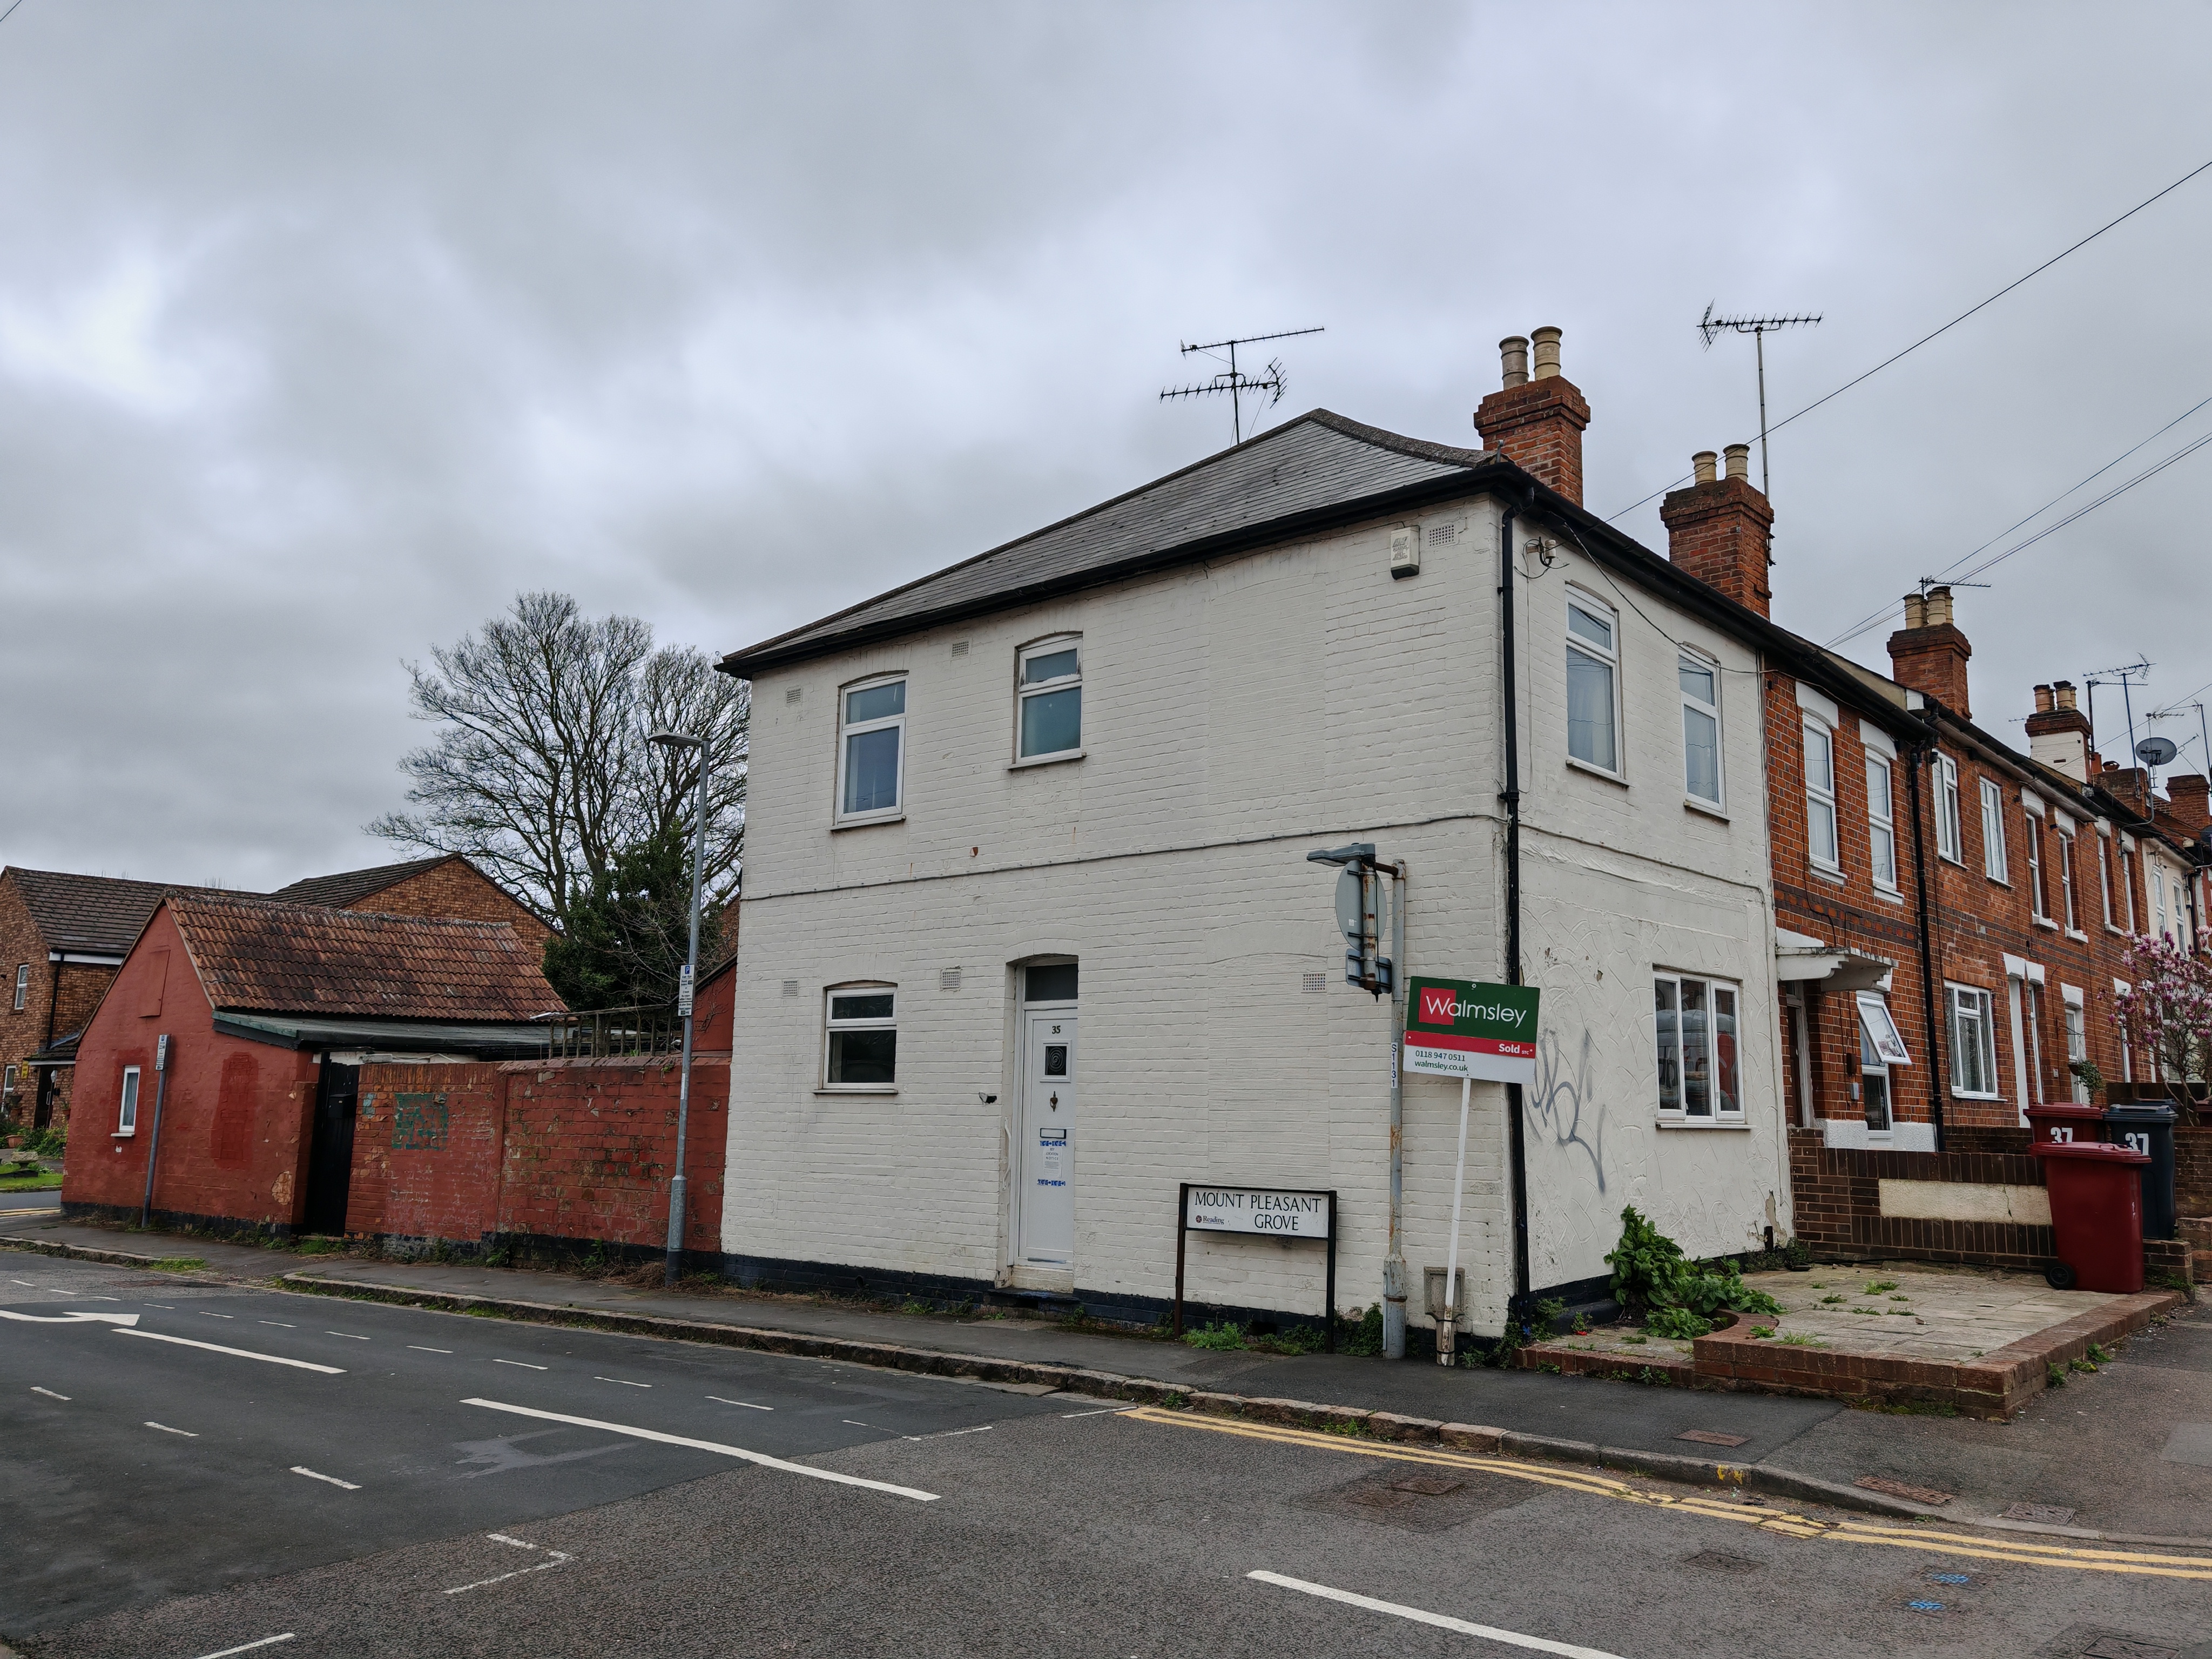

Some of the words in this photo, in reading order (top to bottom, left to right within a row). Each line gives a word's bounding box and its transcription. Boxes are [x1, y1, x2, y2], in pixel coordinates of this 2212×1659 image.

[1426, 995, 1527, 1029] Walmsley
[1052, 1026, 1061, 1034] 35
[1499, 1043, 1520, 1054] Sold
[1415, 1050, 1432, 1058] 0118
[1434, 1052, 1447, 1060] 947
[1448, 1054, 1466, 1062] 0511
[1414, 1060, 1468, 1072] walmsley.co.uk
[2051, 1127, 2073, 1144] 37
[2125, 1132, 2149, 1156] 37
[1195, 1191, 1244, 1208] MOUNT
[1250, 1195, 1321, 1213] PLEASANT
[1203, 1215, 1224, 1225] Reading
[1255, 1214, 1299, 1231] GROVE
